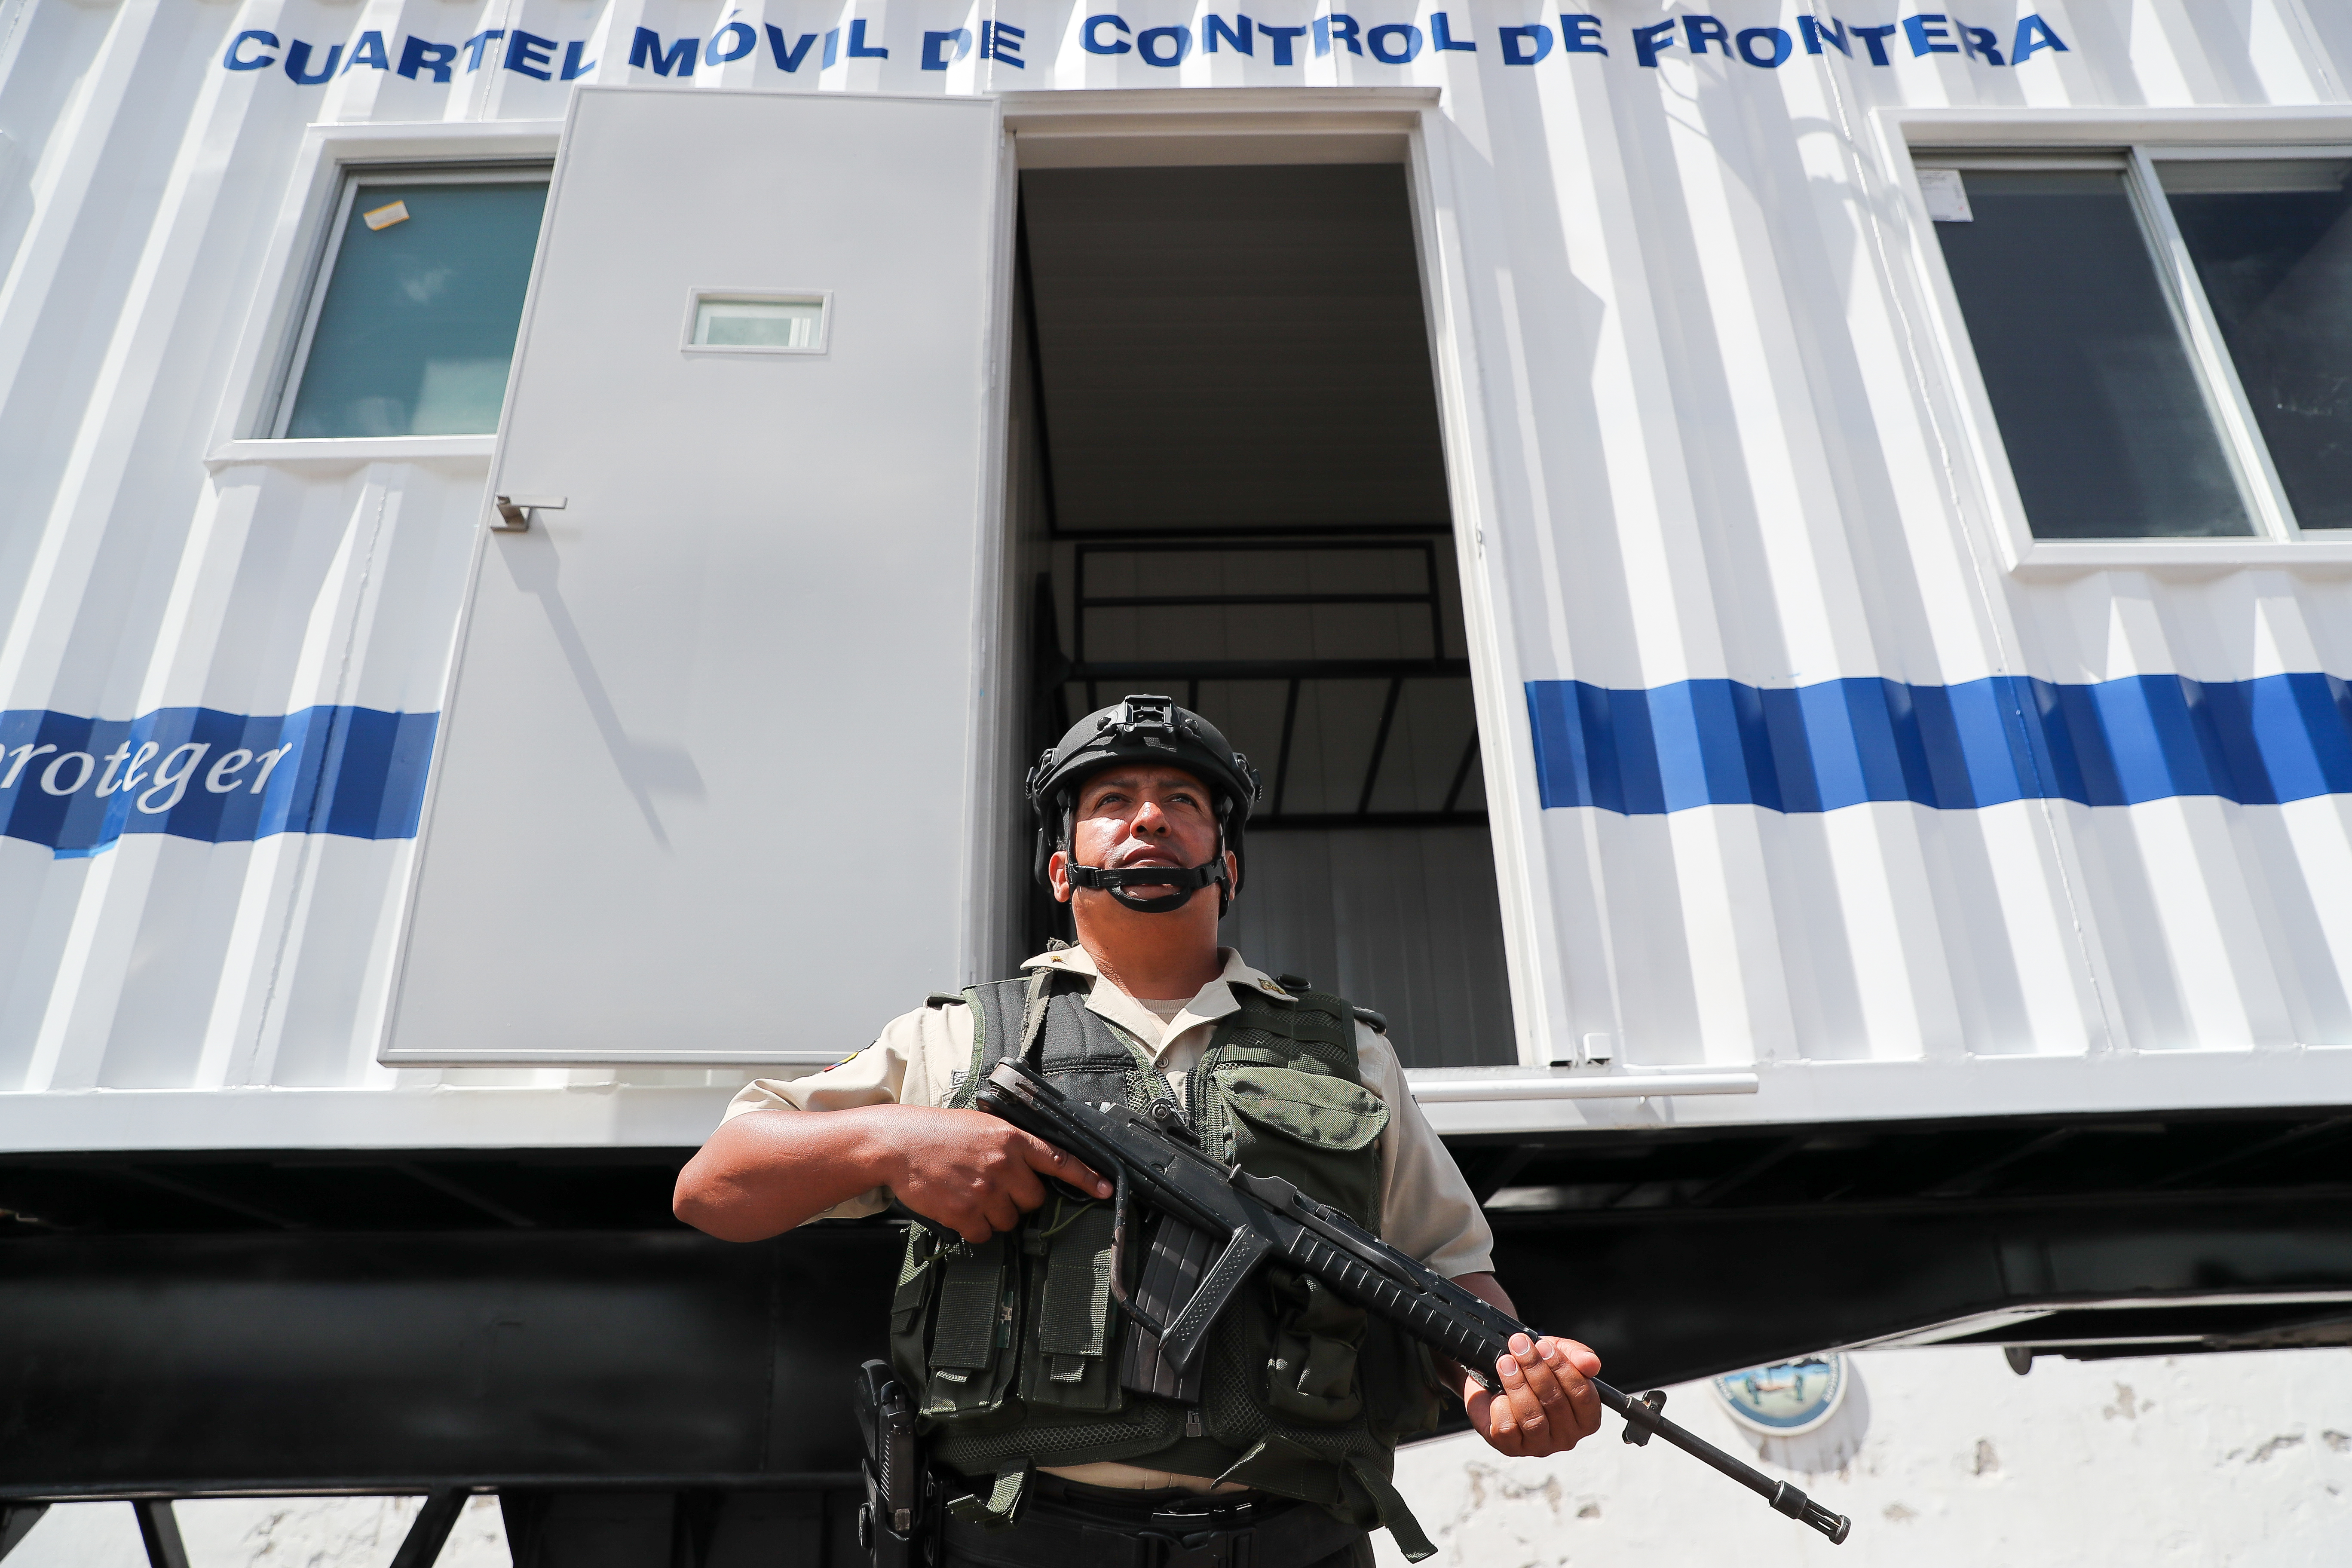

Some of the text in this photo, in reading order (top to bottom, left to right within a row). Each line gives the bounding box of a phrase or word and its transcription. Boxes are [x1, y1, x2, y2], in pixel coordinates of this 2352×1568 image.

[223, 10, 2070, 86] CUARTEL MÓVIL DE CONTROL DE FRONTERA
[0, 739, 293, 815] roteger
